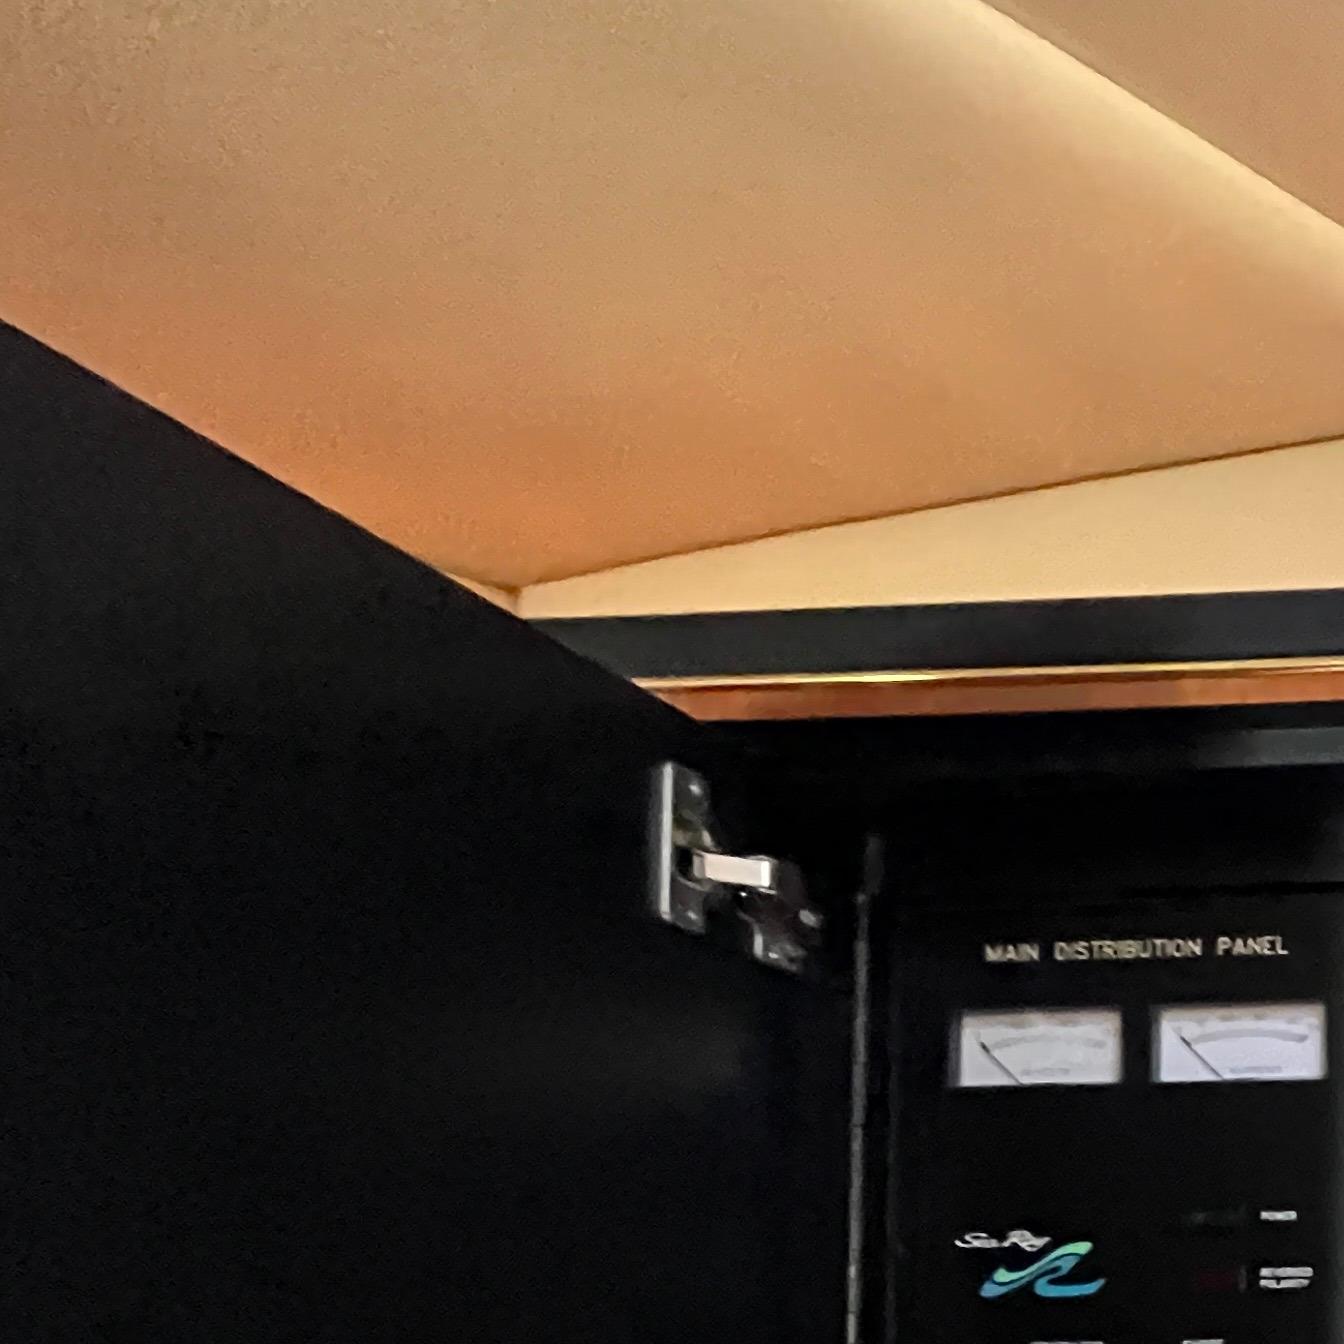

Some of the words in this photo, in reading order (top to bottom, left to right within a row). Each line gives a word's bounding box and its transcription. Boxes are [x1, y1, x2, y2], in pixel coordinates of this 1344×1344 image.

[985, 943, 1040, 962] MAIN
[1054, 938, 1203, 961] DISTRIBUTION
[1216, 935, 1289, 956] PANEL
